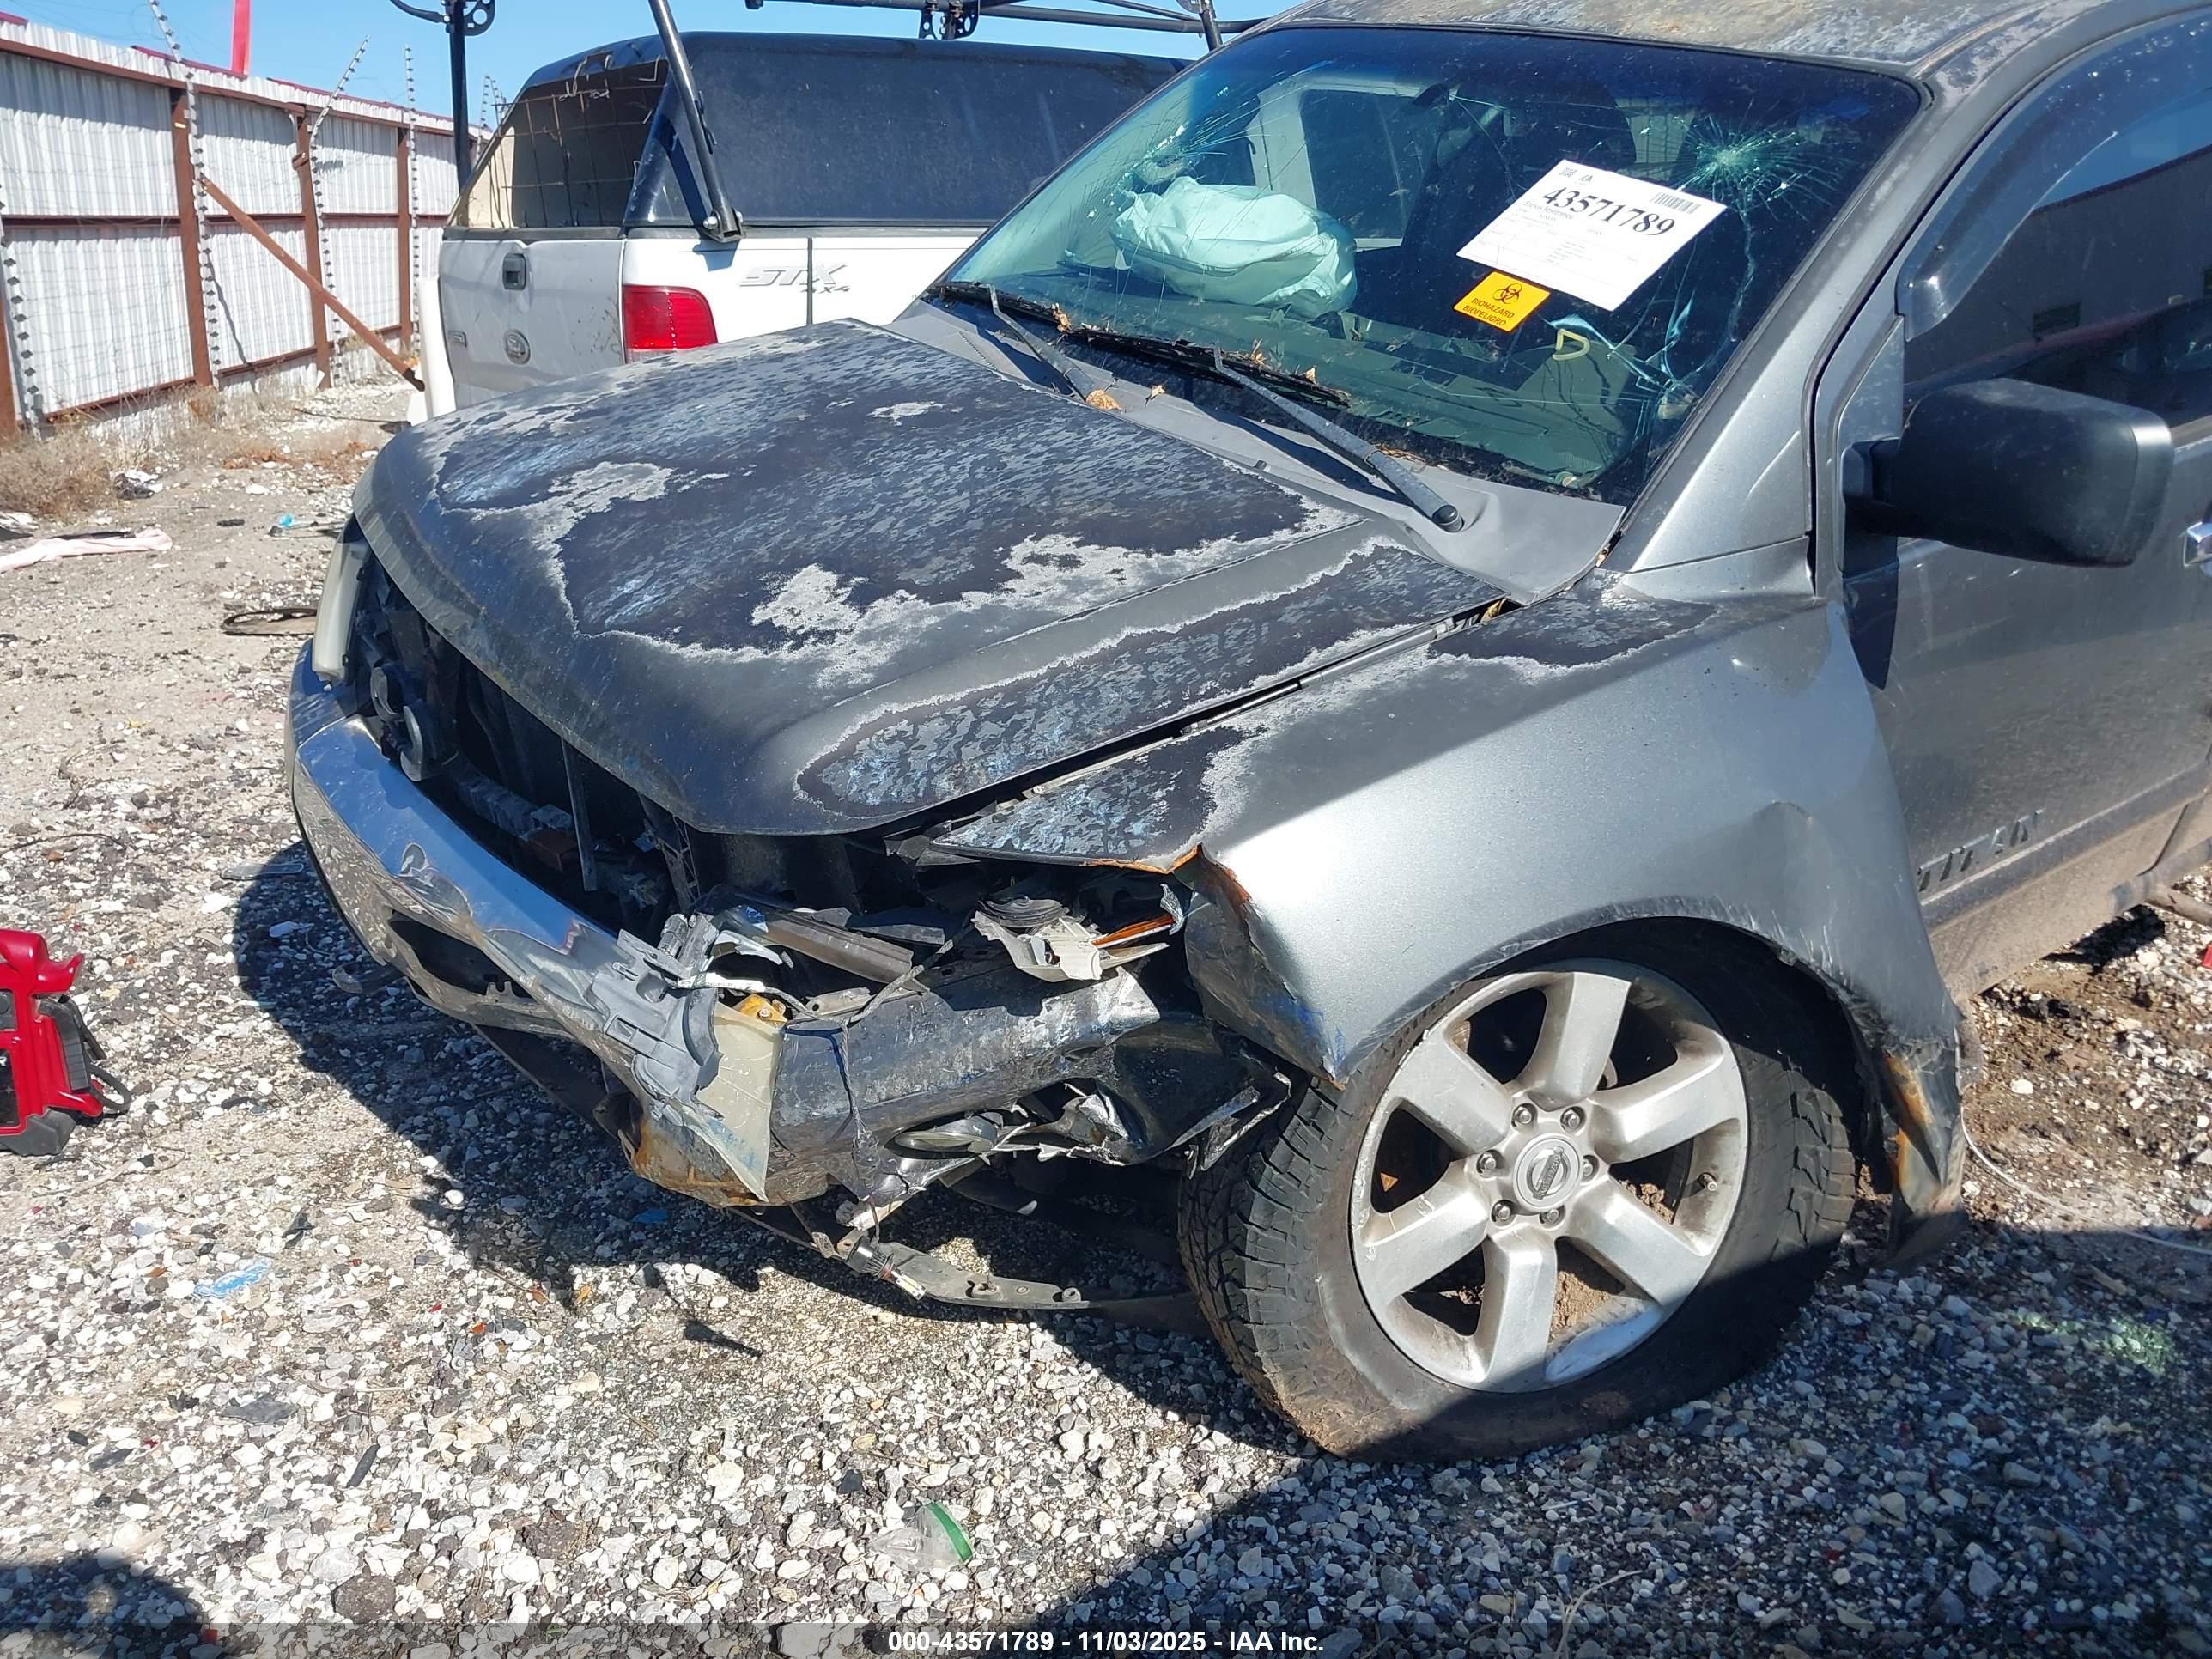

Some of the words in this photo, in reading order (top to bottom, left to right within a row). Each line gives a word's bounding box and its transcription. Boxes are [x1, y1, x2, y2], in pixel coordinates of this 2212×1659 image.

[1542, 186, 1676, 237] 43571789
[739, 264, 848, 287] STX
[1462, 305, 1507, 326] BIOPELIGRO
[1471, 297, 1516, 319] BIOHAZARD
